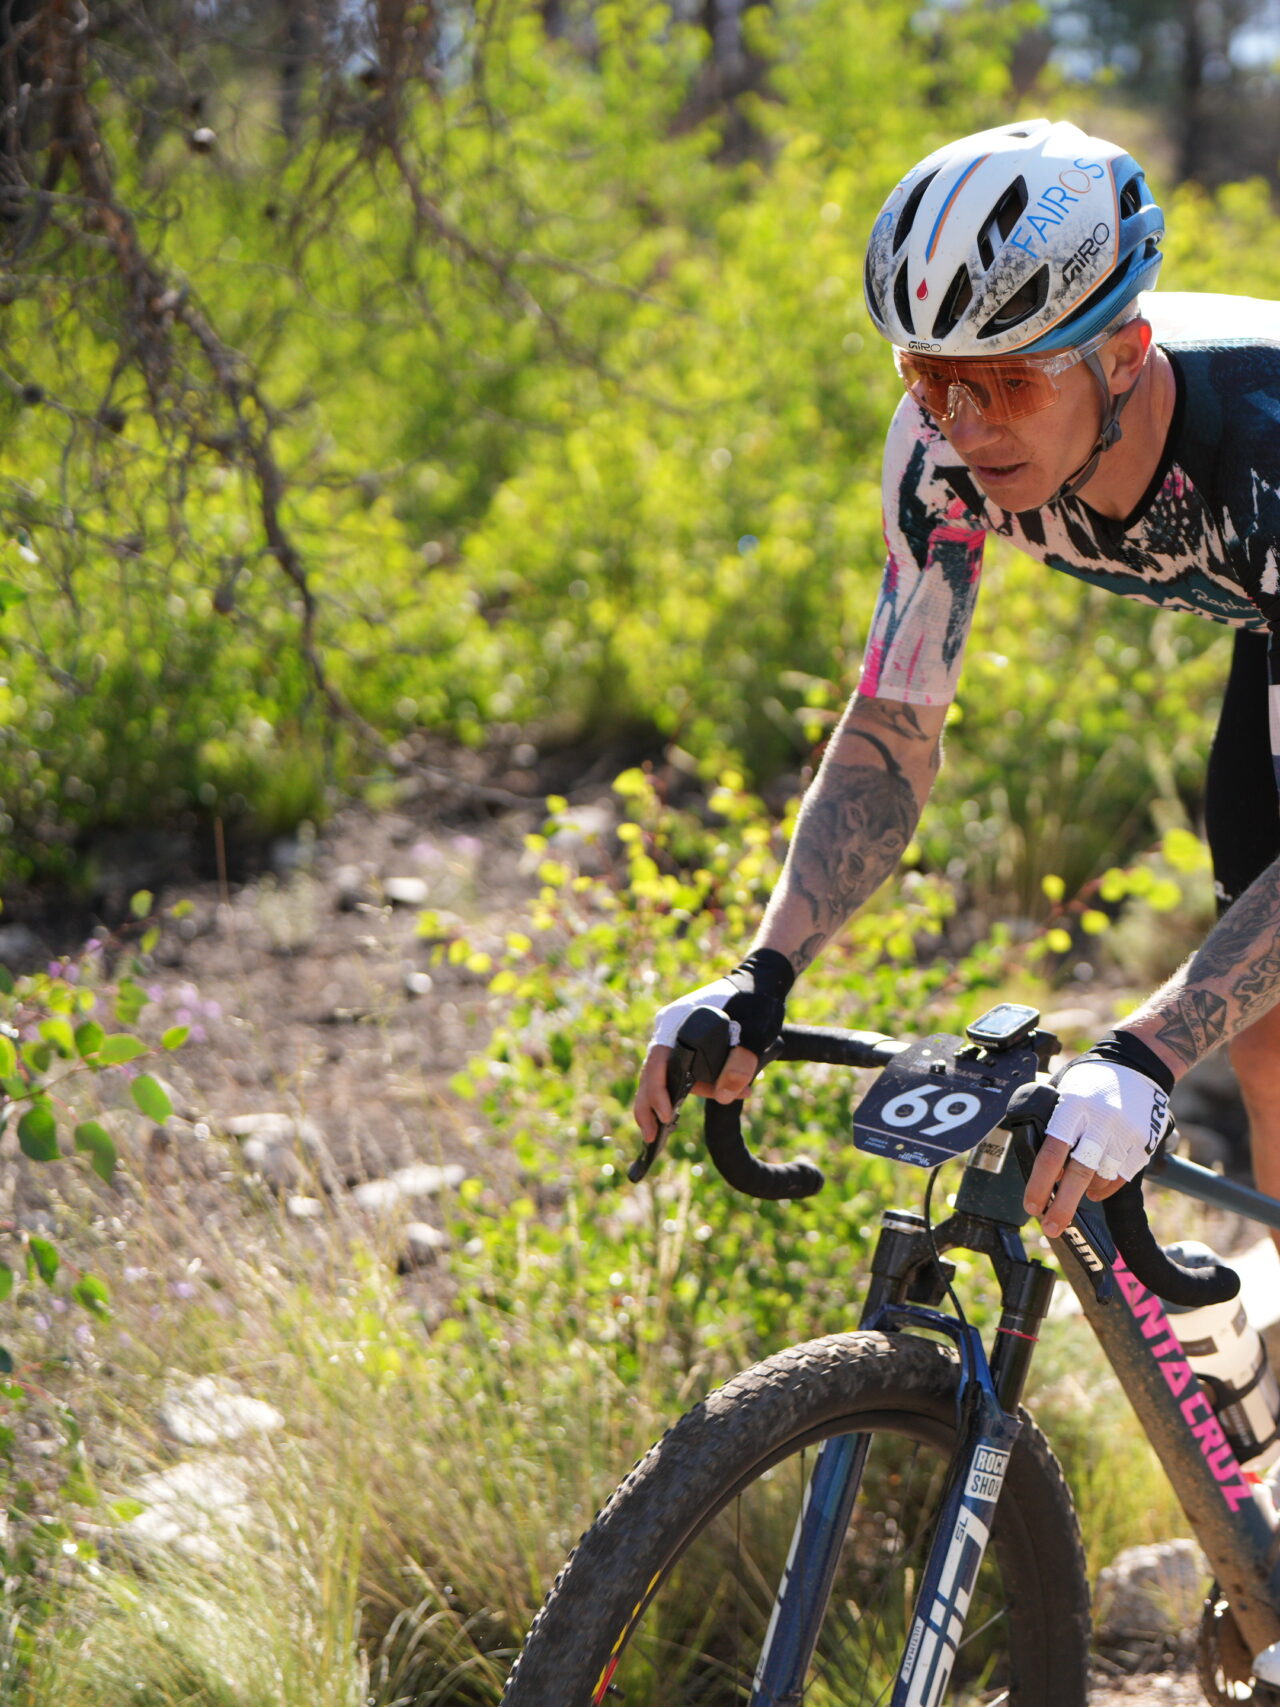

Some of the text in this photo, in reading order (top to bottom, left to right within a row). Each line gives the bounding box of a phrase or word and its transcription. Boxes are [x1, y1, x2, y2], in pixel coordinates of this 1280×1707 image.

[1010, 157, 1105, 259] FAIROS
[880, 1083, 982, 1137] 69
[1144, 1088, 1168, 1156] GIRO
[1179, 1390, 1253, 1513] CRUZ
[903, 1624, 922, 1674] ULTIMATE
